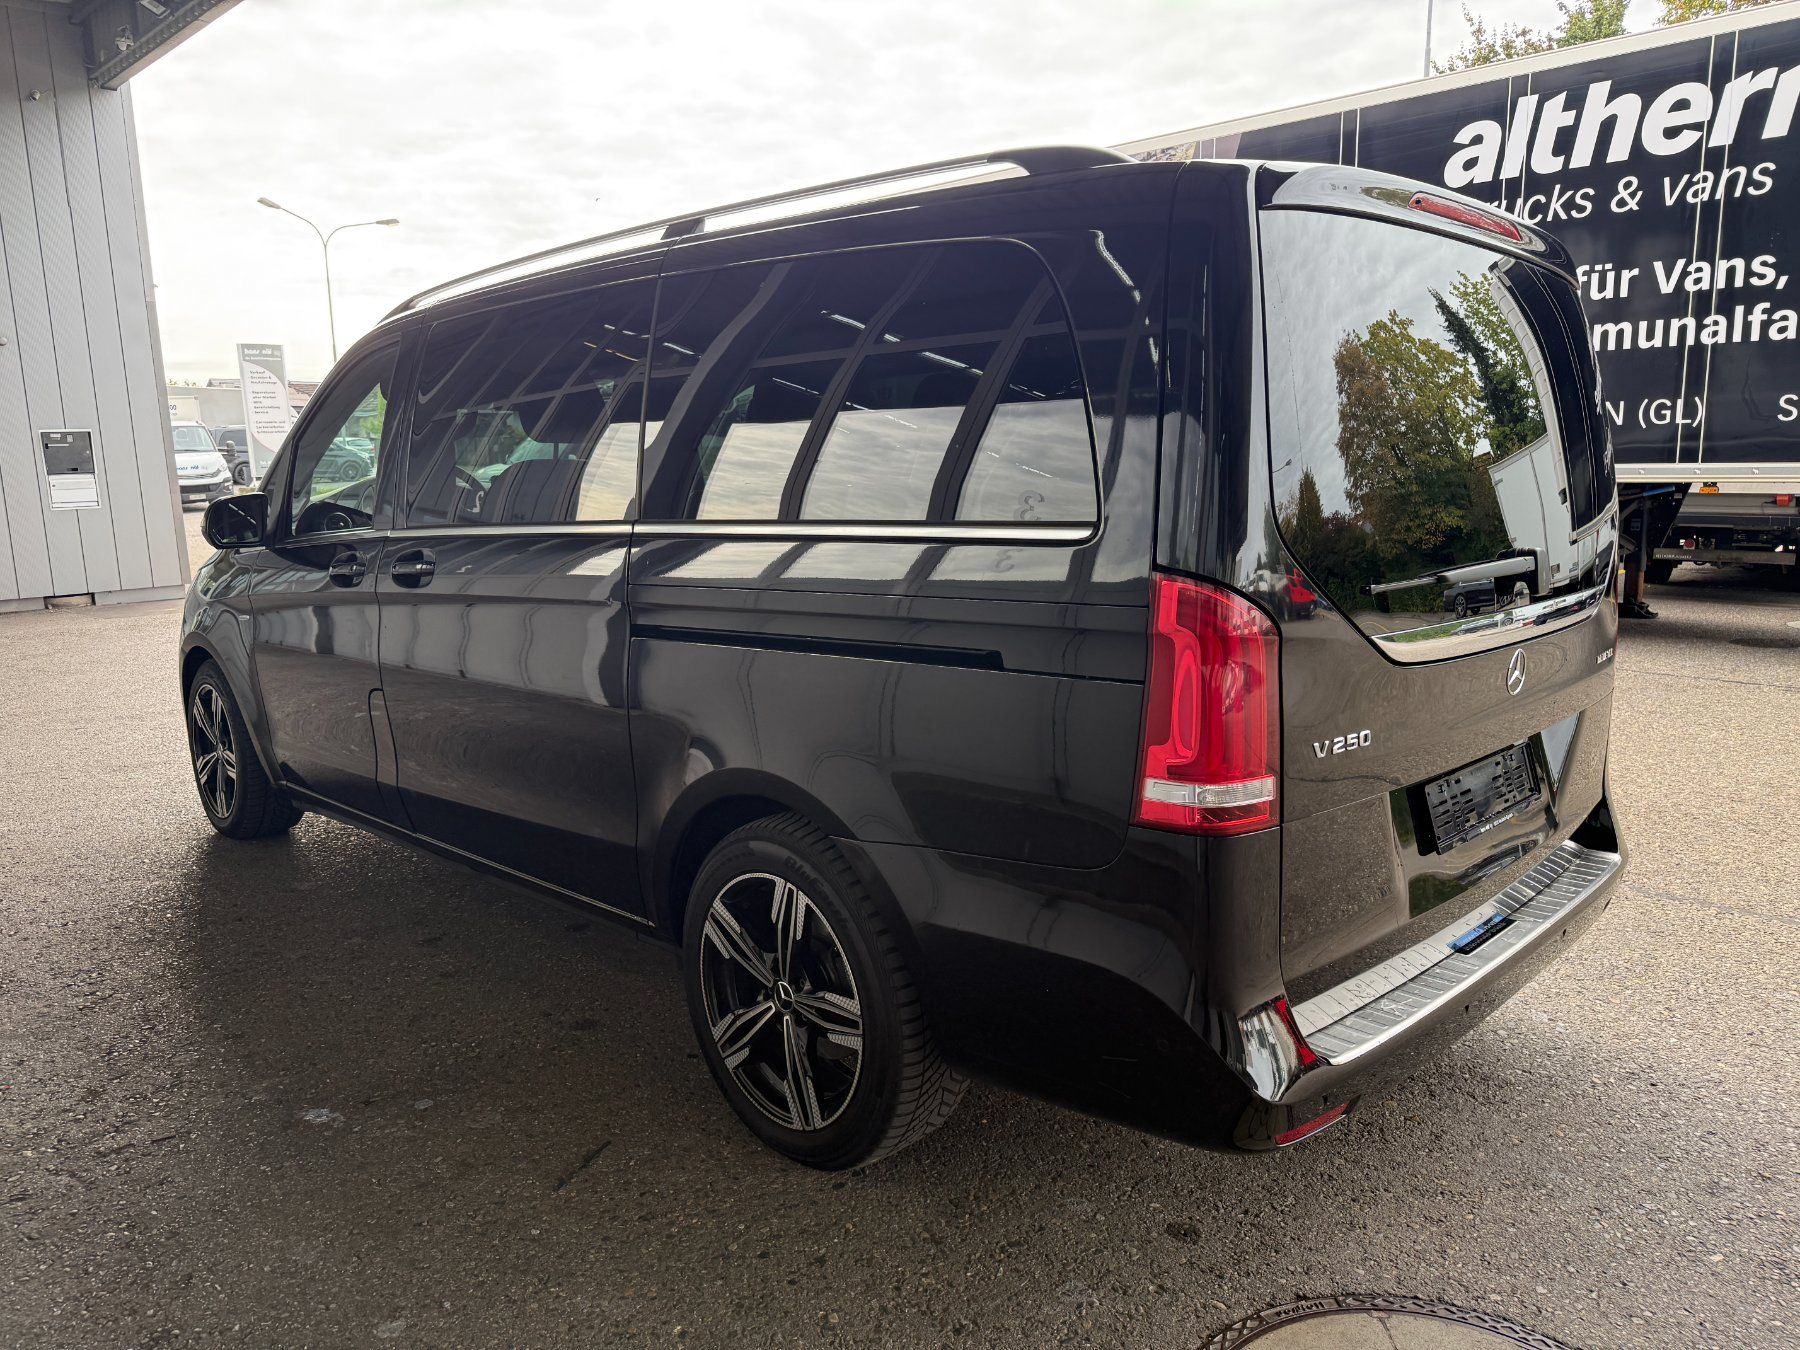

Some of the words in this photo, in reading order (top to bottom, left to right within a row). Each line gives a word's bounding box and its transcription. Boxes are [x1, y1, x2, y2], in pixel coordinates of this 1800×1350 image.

[1609, 175, 1644, 213] &
[1663, 161, 1777, 206] vans
[1652, 254, 1790, 295] Vans,
[1638, 396, 1703, 429] (GL)
[1777, 393, 1800, 422] S
[1312, 740, 1330, 759] V
[1332, 729, 1372, 755] 250
